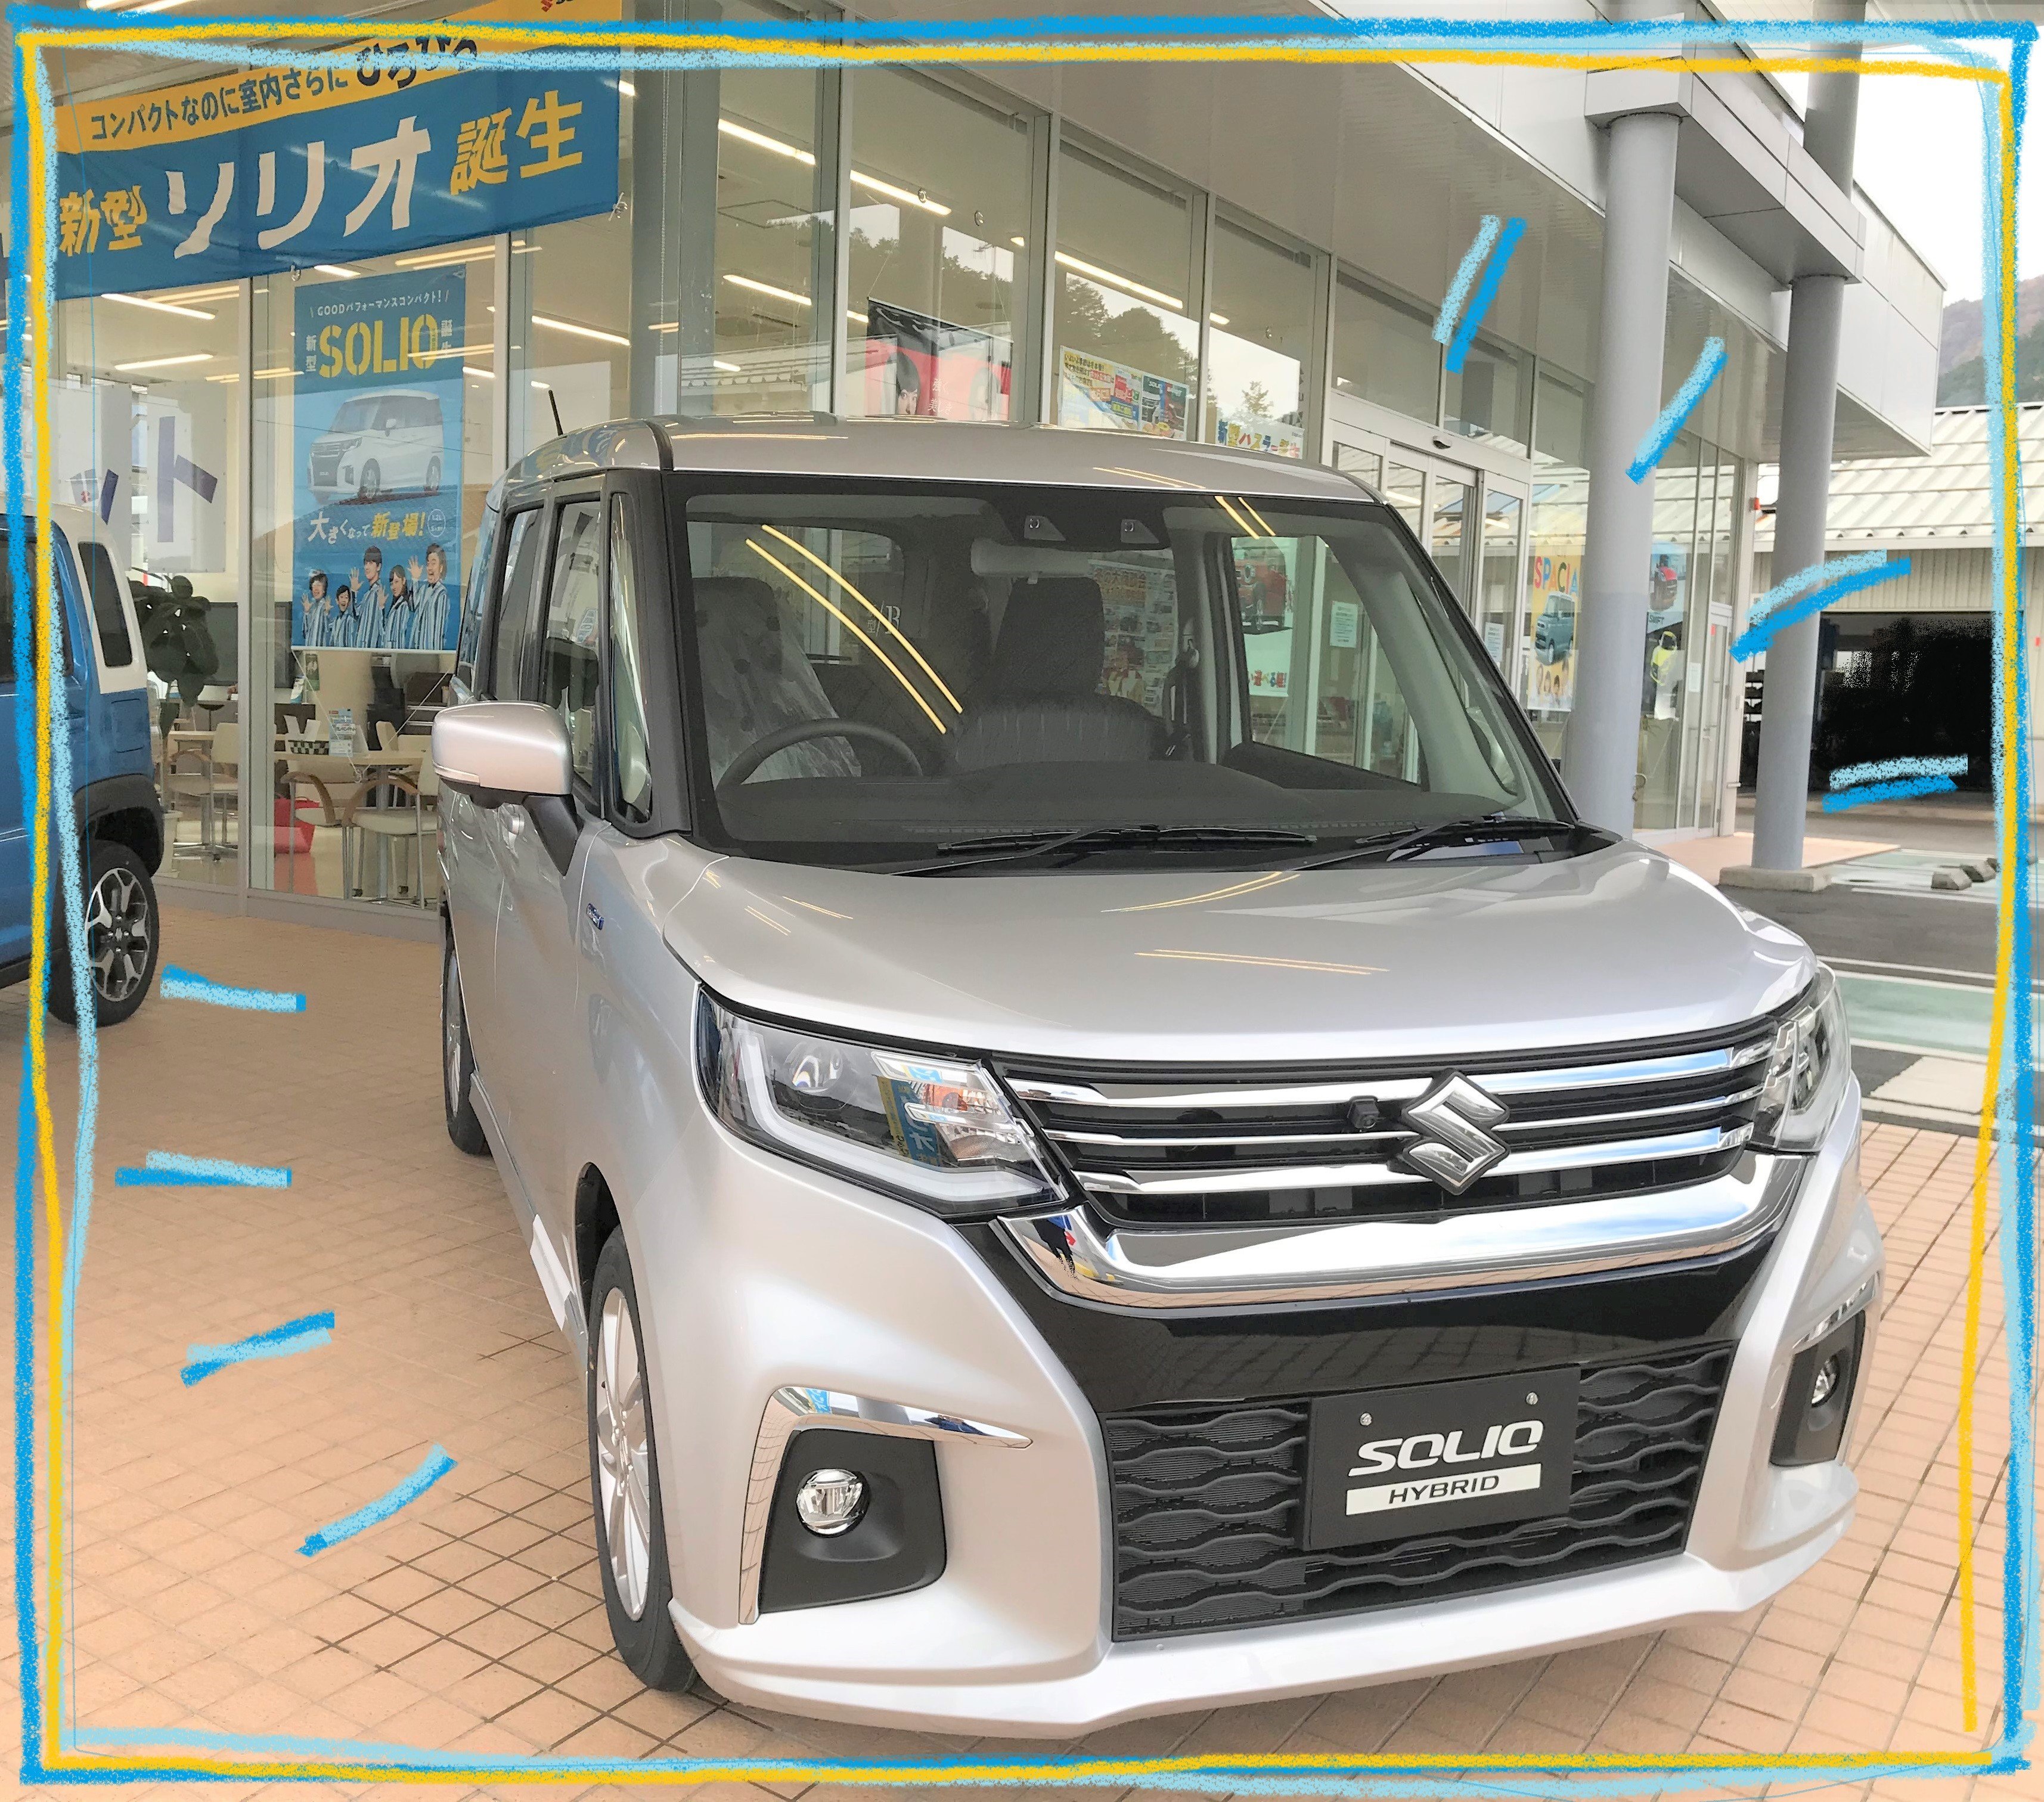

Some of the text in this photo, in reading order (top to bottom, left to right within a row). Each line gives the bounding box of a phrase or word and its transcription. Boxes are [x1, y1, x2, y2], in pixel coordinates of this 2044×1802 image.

[319, 314, 438, 378] SOLIO
[1534, 556, 1580, 598] SPACIA
[1348, 1420, 1544, 1477] SOLIO
[1388, 1475, 1499, 1505] HYBRID
